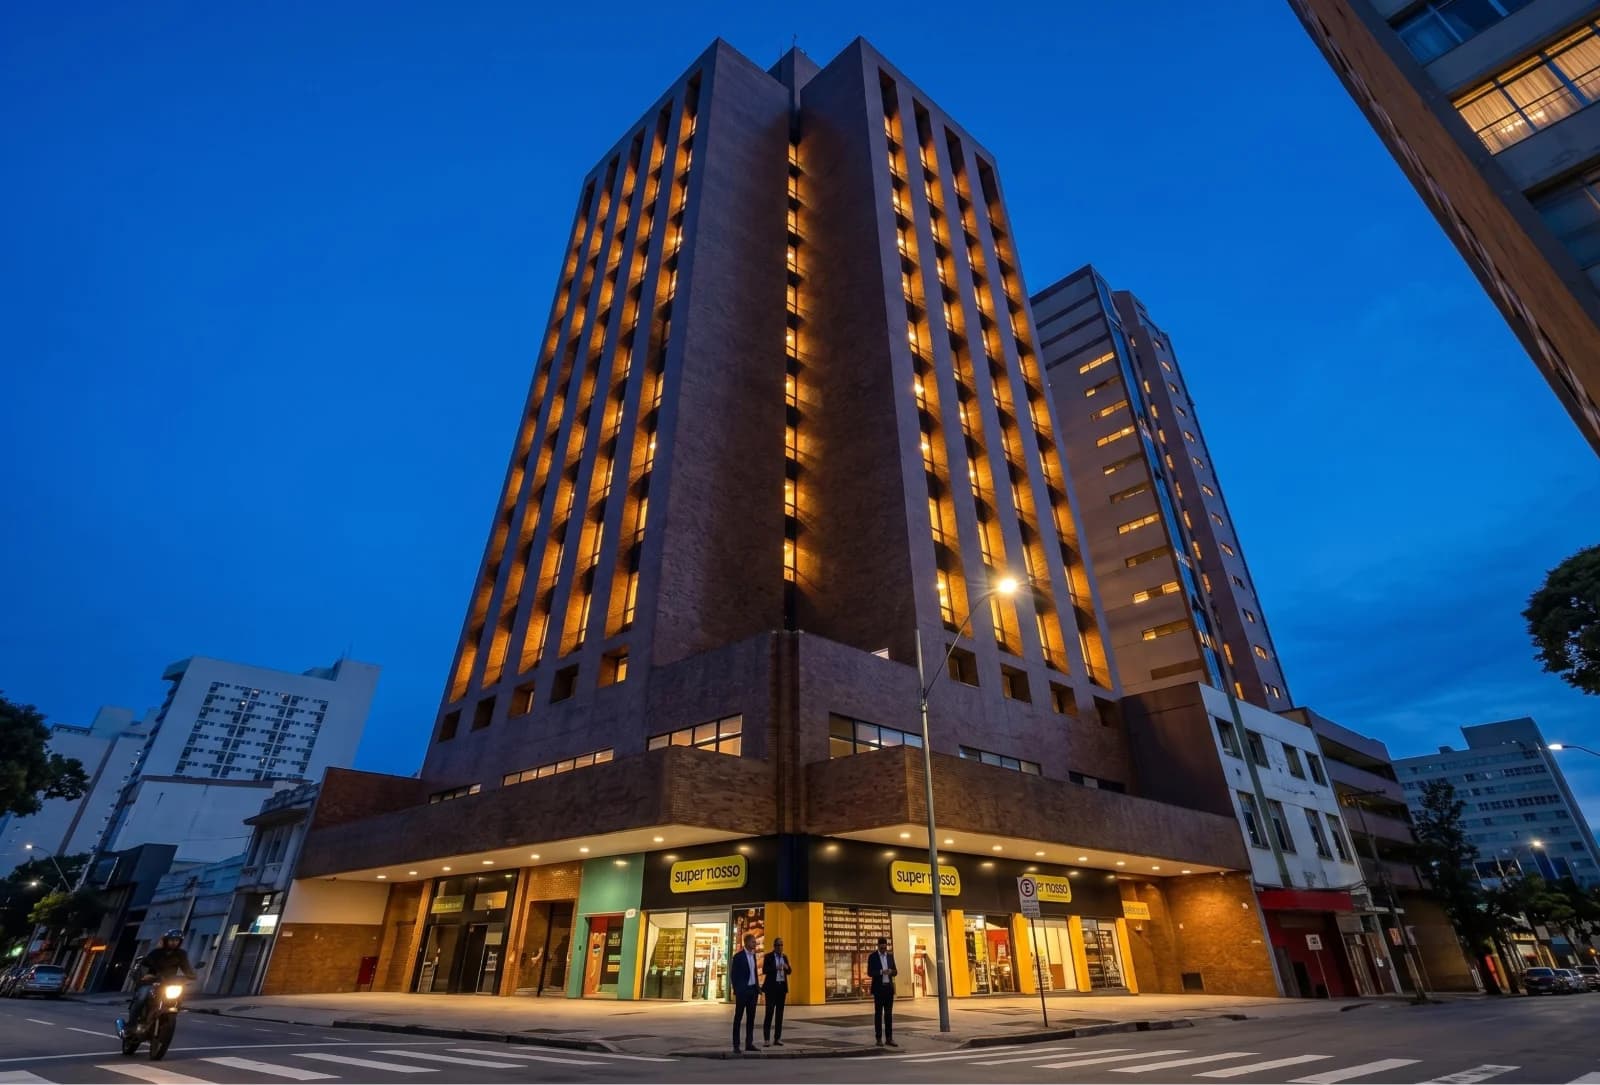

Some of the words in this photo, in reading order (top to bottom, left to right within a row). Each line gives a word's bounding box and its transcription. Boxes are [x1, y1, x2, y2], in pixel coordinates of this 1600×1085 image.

[675, 869, 705, 885] super
[706, 864, 740, 880] nosso
[896, 870, 926, 887] super
[1023, 882, 1031, 893] E
[1045, 882, 1068, 894] nosso
